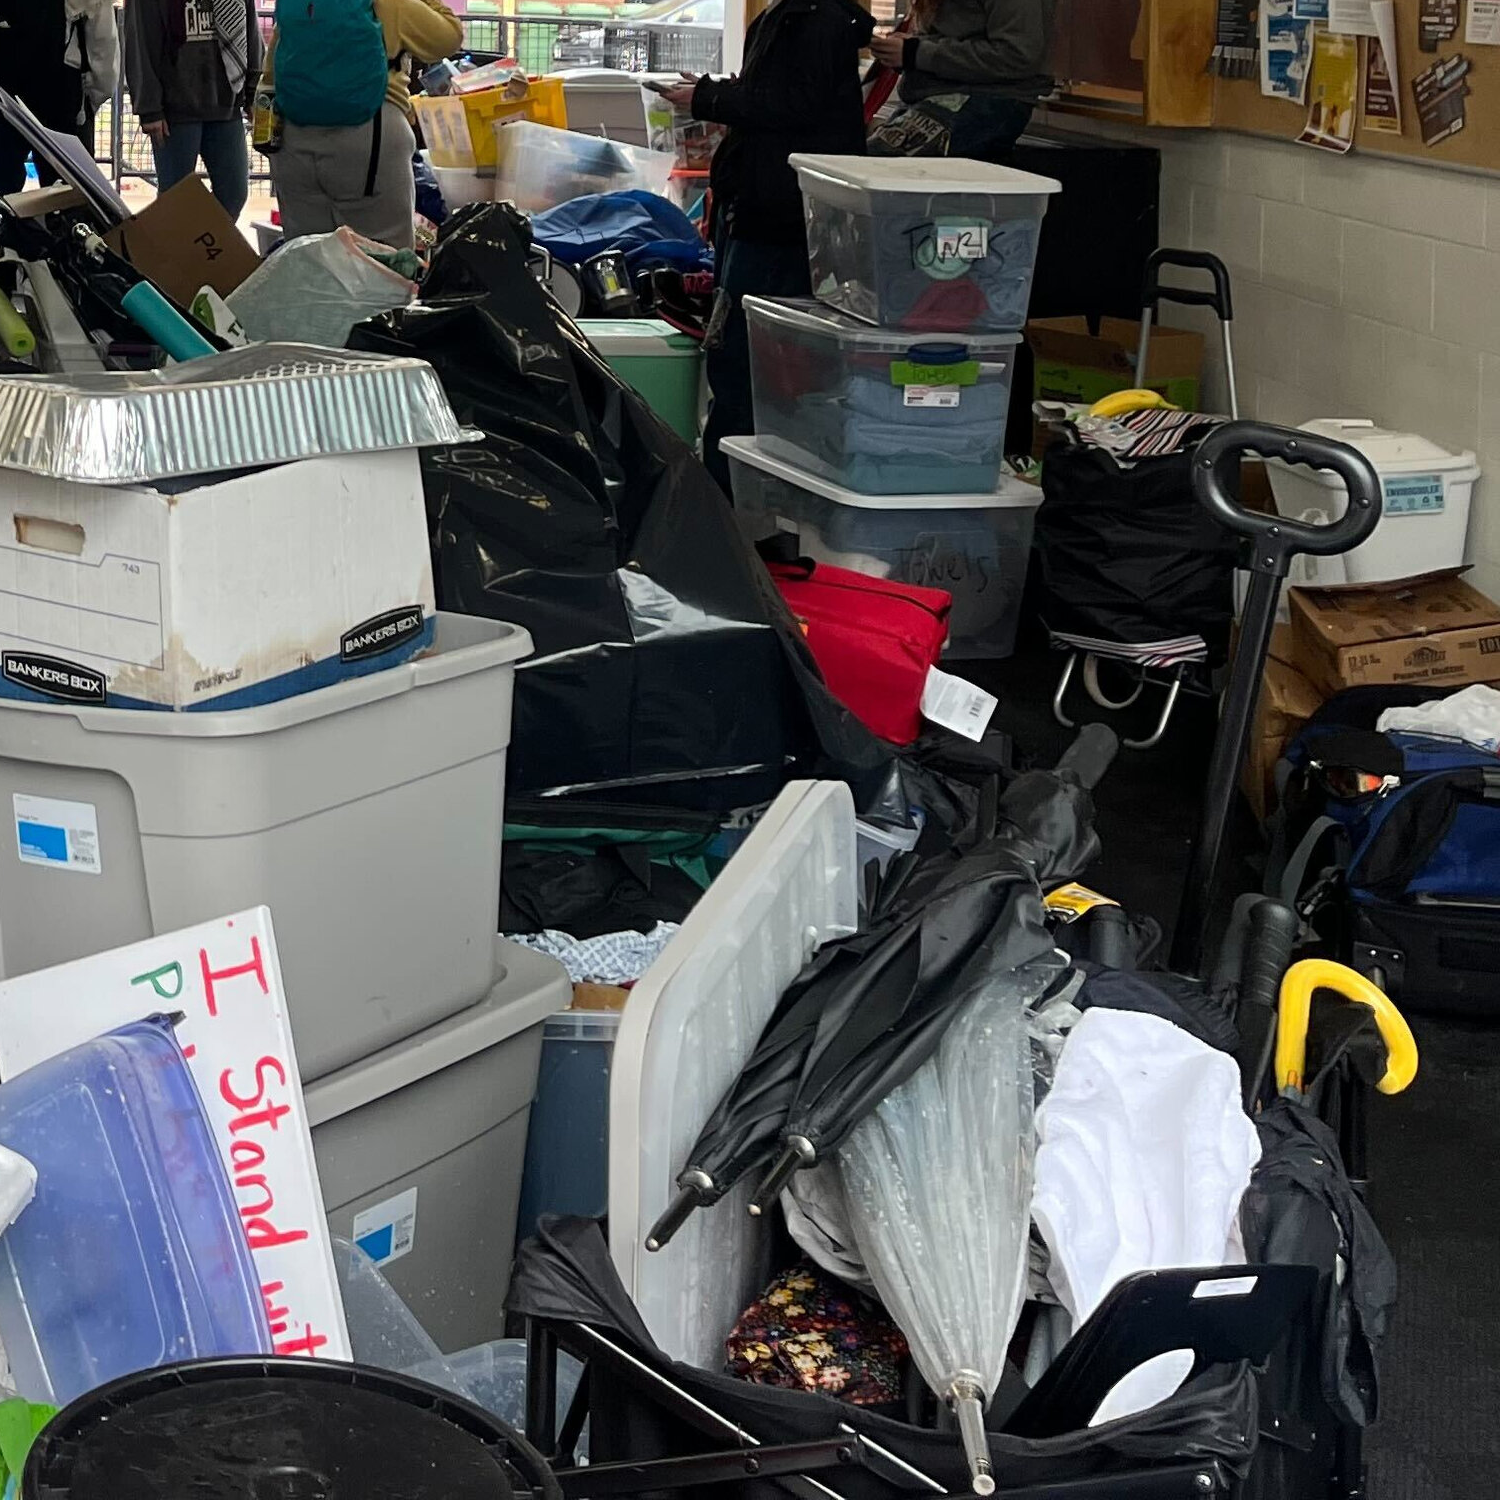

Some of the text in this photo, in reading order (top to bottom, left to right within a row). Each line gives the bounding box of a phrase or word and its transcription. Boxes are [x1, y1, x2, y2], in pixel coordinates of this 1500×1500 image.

[193, 231, 224, 261] P4
[345, 614, 420, 653] BANKERS BOX
[7, 659, 101, 694] BANKERS BOX
[198, 934, 329, 1357] I Stand wit
